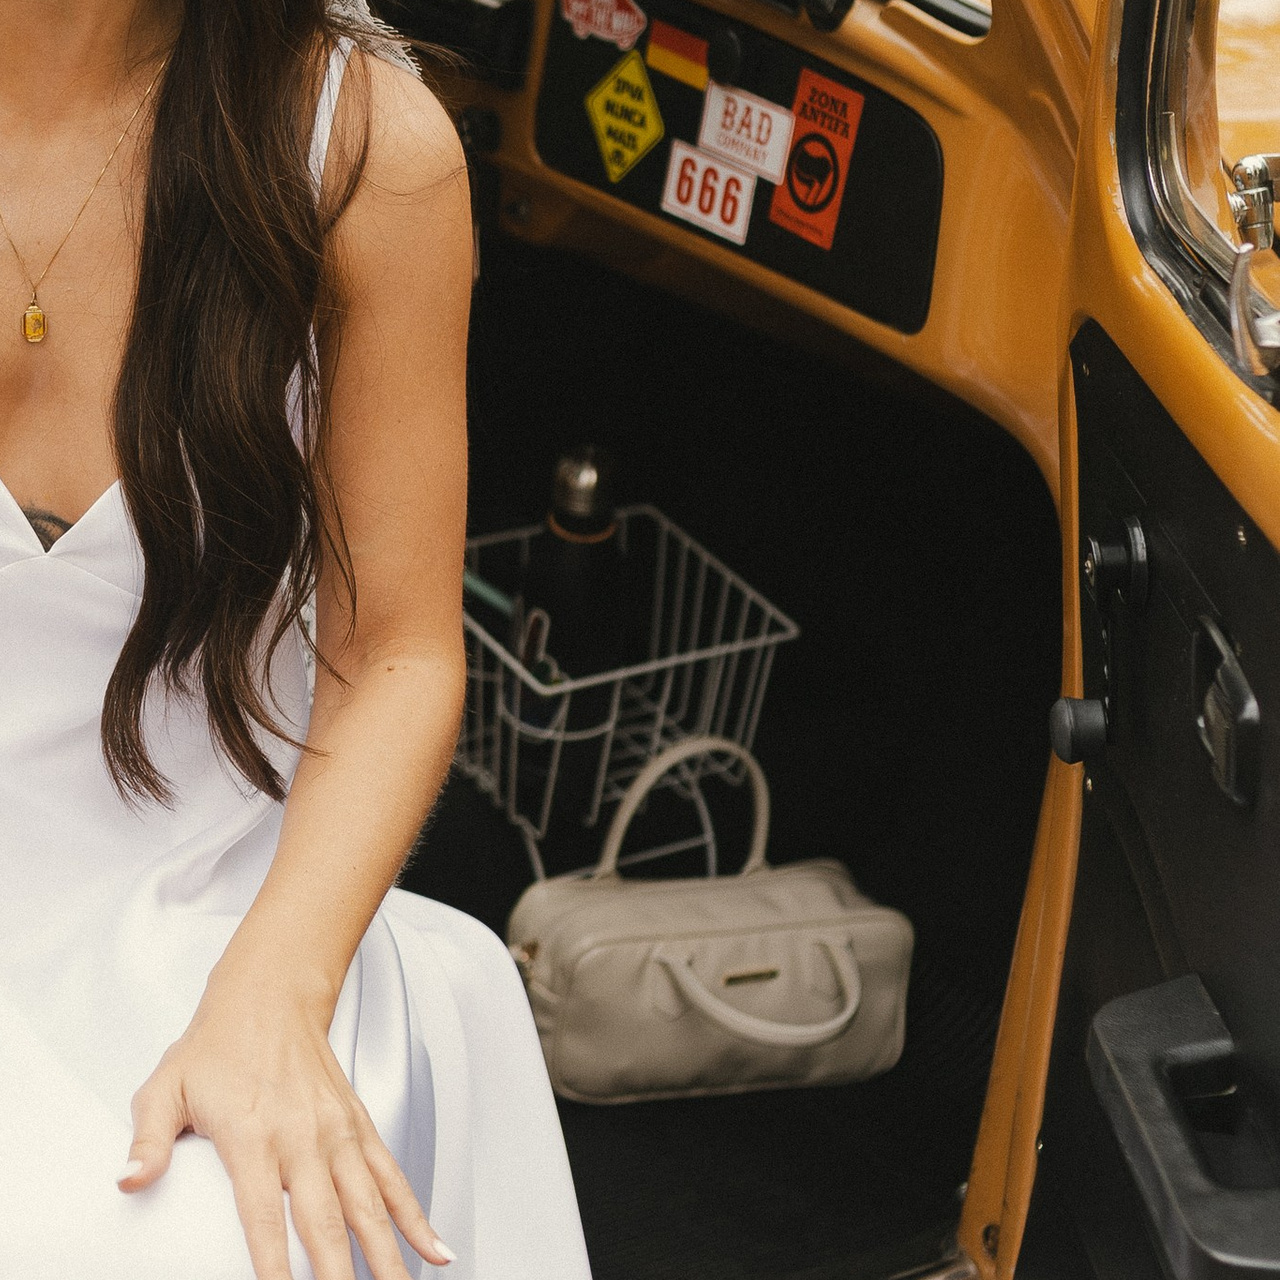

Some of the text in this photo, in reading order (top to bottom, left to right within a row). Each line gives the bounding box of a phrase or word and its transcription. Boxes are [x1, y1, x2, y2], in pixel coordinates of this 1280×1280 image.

[605, 99, 647, 128] NUNCA
[799, 102, 849, 139] ANTIFA
[809, 86, 848, 118] ZONA
[721, 96, 772, 146] BAD
[676, 157, 742, 225] 666
